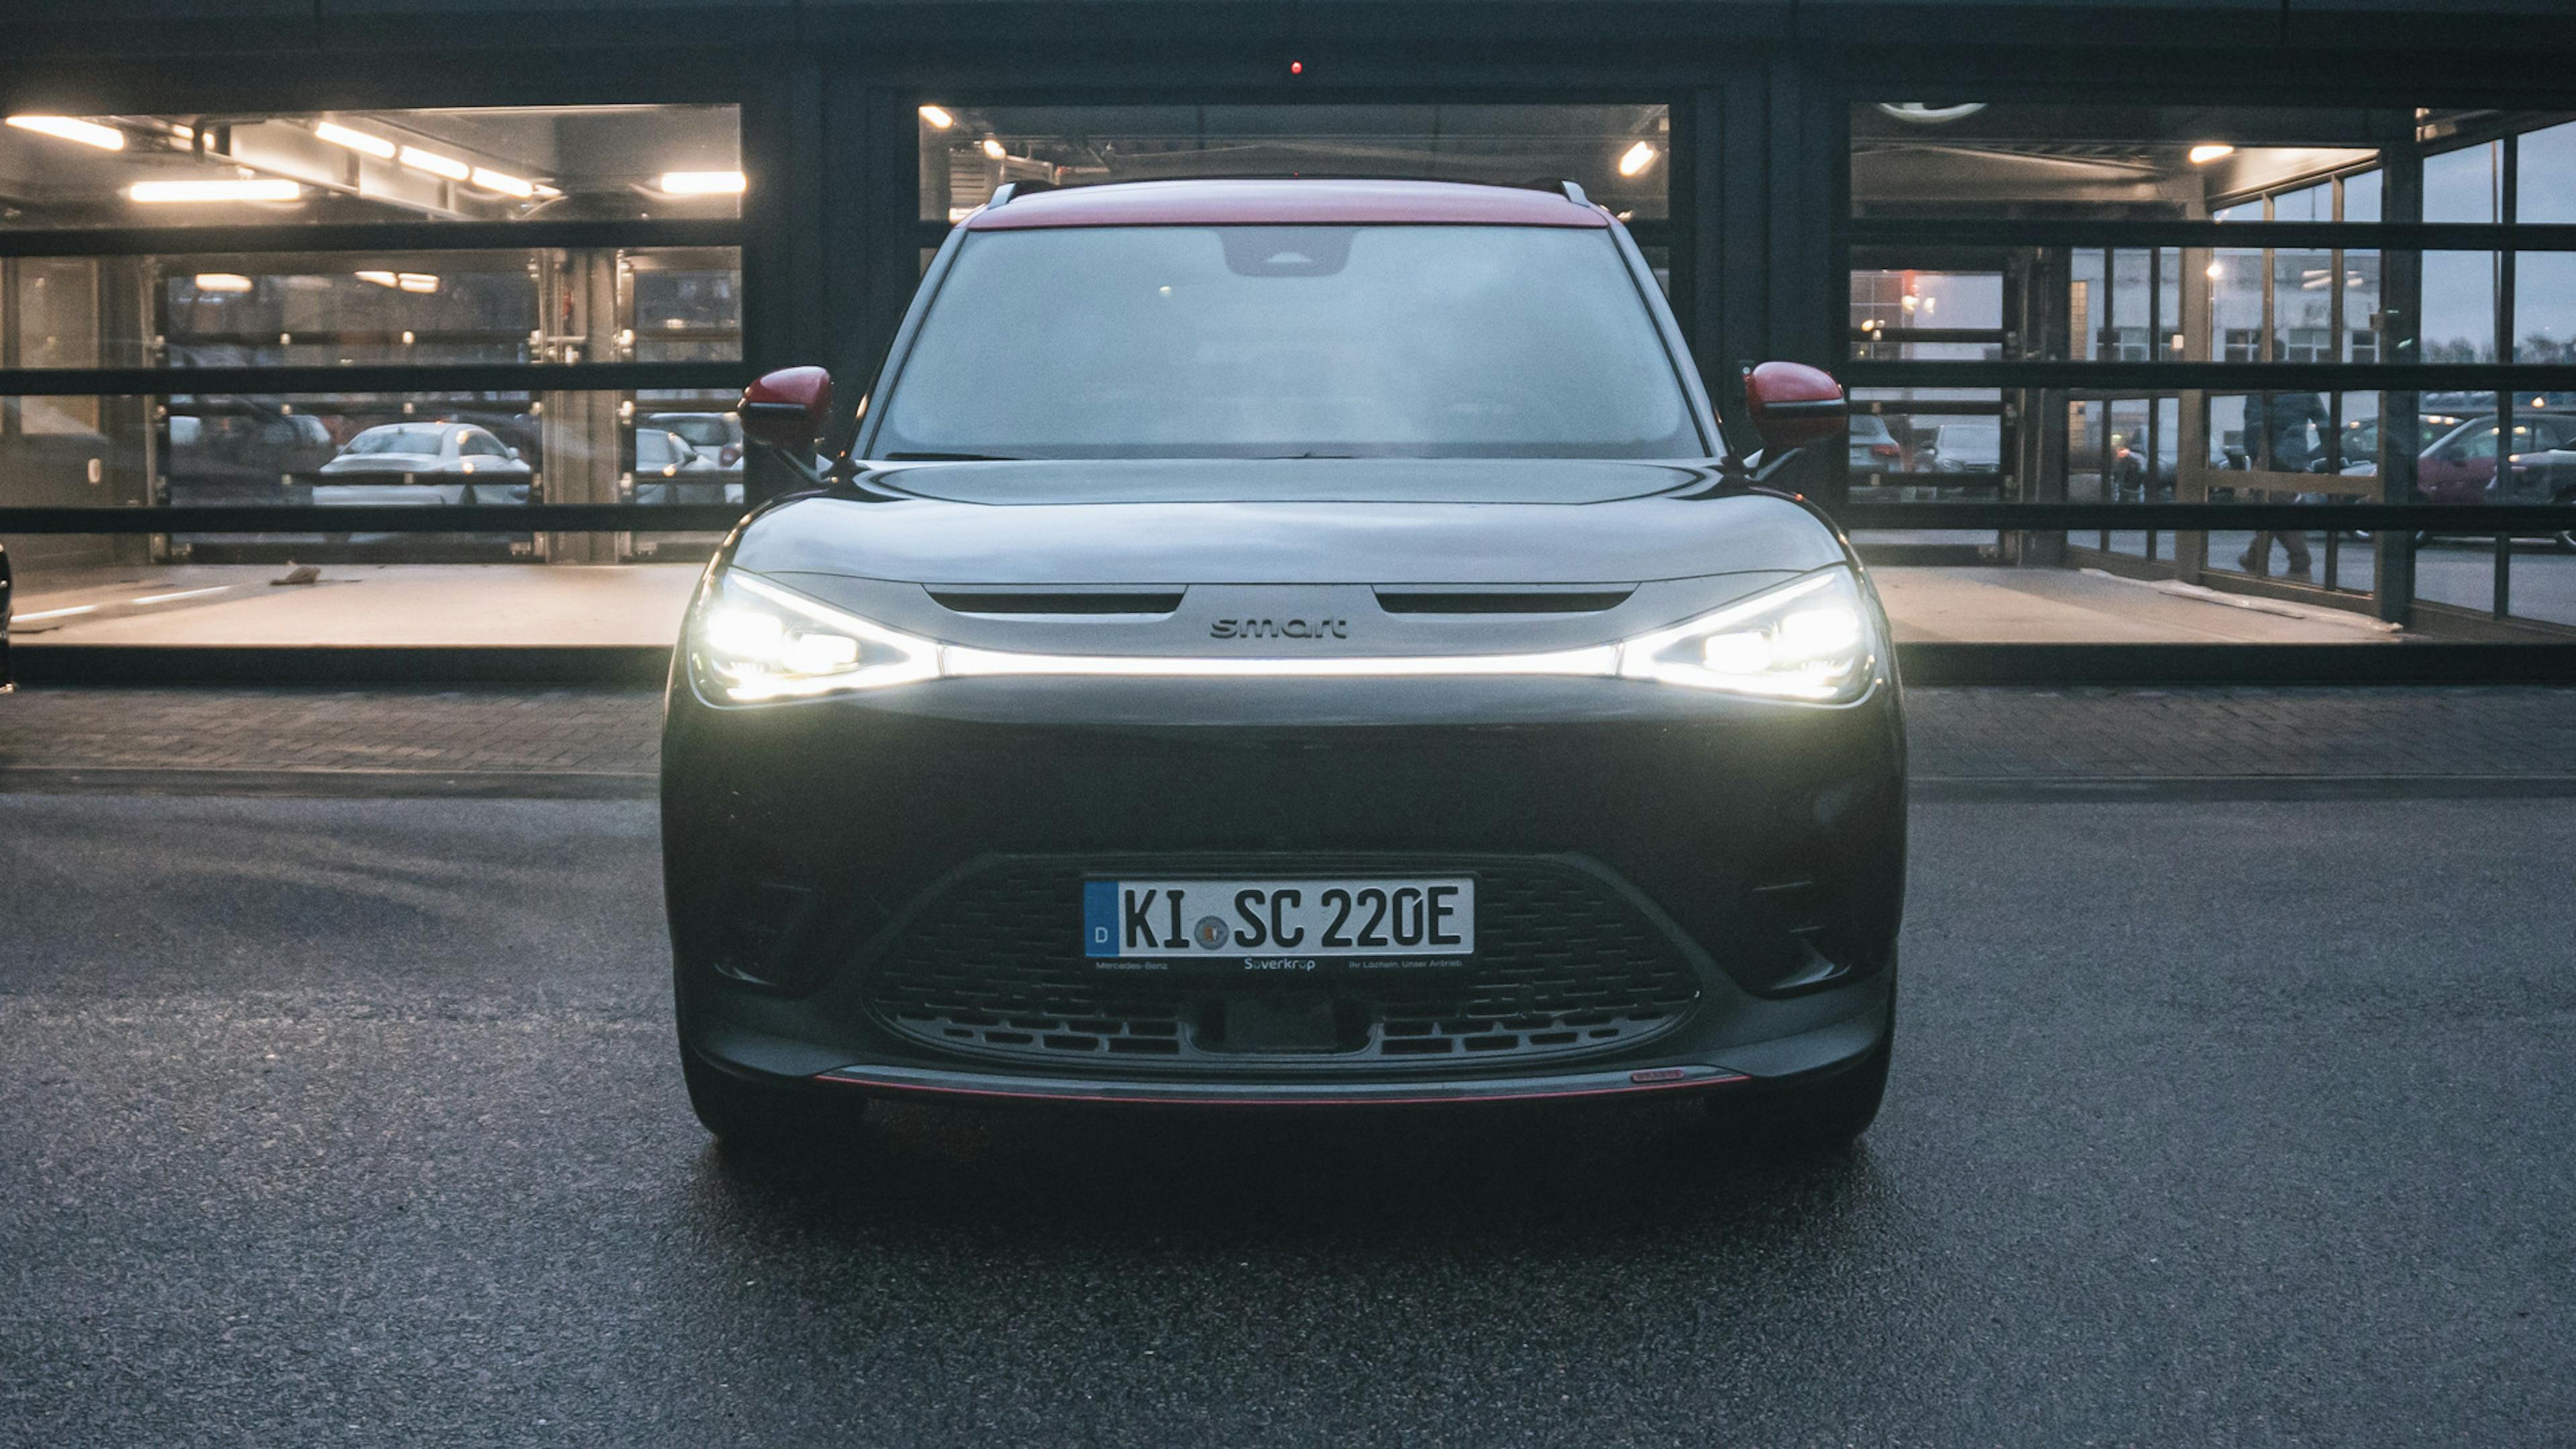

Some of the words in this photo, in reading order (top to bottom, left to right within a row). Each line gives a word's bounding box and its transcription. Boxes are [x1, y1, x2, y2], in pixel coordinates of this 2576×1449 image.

[1210, 616, 1347, 639] smart
[1124, 889, 1191, 949] KI
[1234, 889, 1305, 947] SC
[1321, 885, 1462, 947] 220E
[1095, 926, 1108, 943] D
